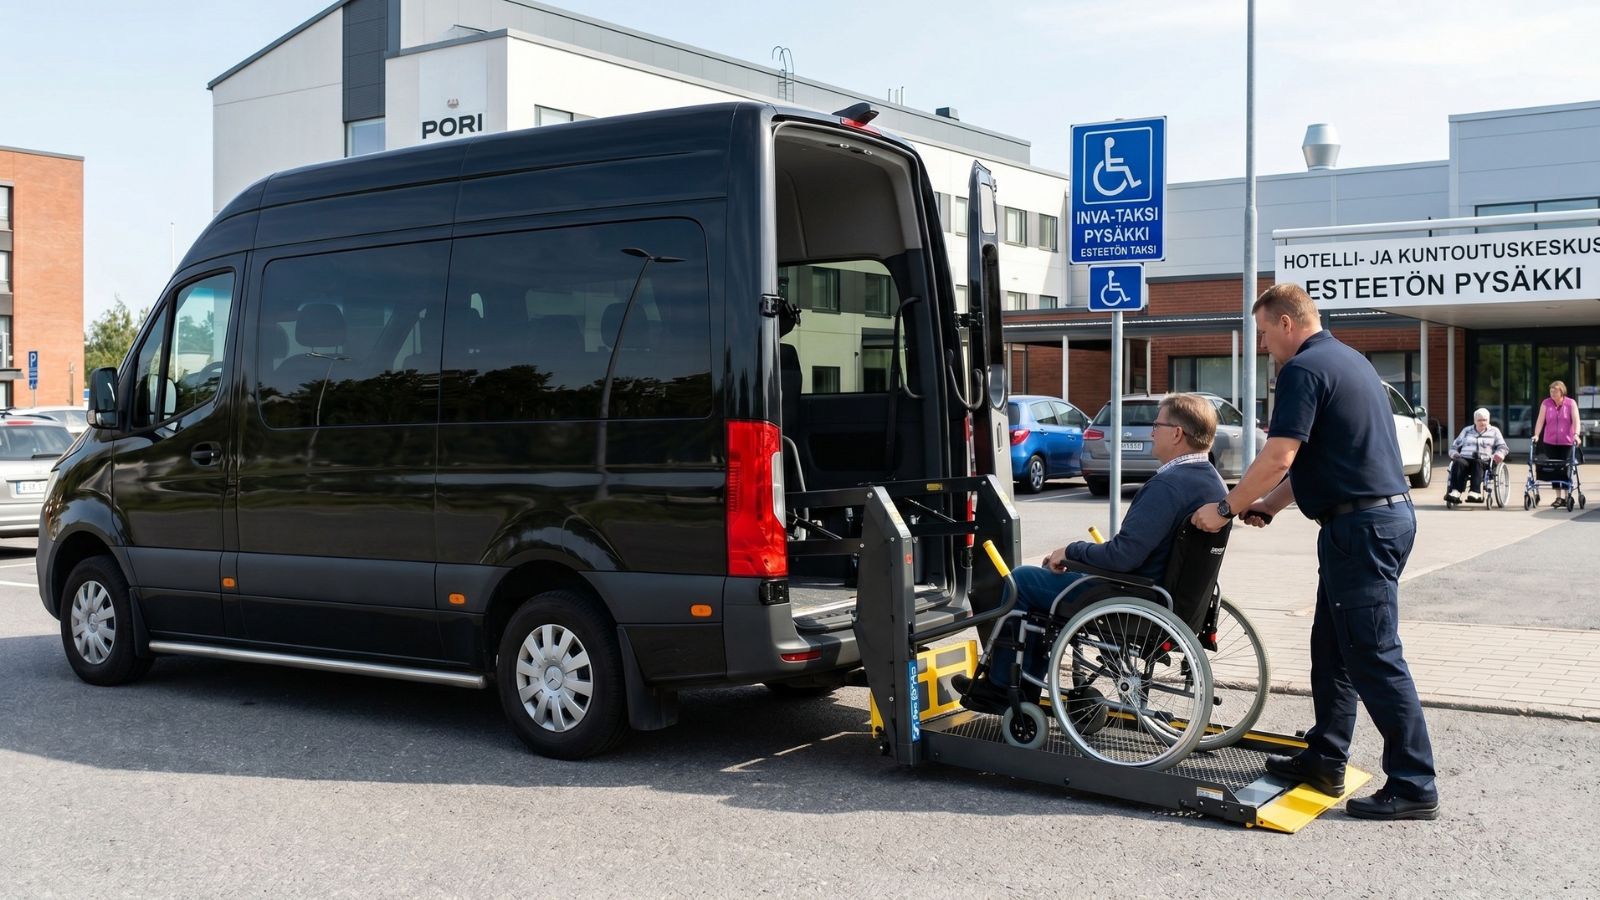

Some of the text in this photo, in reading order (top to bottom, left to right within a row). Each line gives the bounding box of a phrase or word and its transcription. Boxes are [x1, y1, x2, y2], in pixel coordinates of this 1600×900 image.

[422, 113, 482, 139] PORI
[1076, 207, 1158, 224] INVA-TAKSI
[1084, 225, 1149, 243] PYSÄKKI
[1081, 244, 1156, 257] ESTEETÖN TAKSI
[1284, 237, 1600, 269] HOTELLI- JA KUNTOUTUSKESKUS
[1306, 264, 1581, 300] ESTEETÖN PYSÄKKI
[30, 352, 37, 367] P
